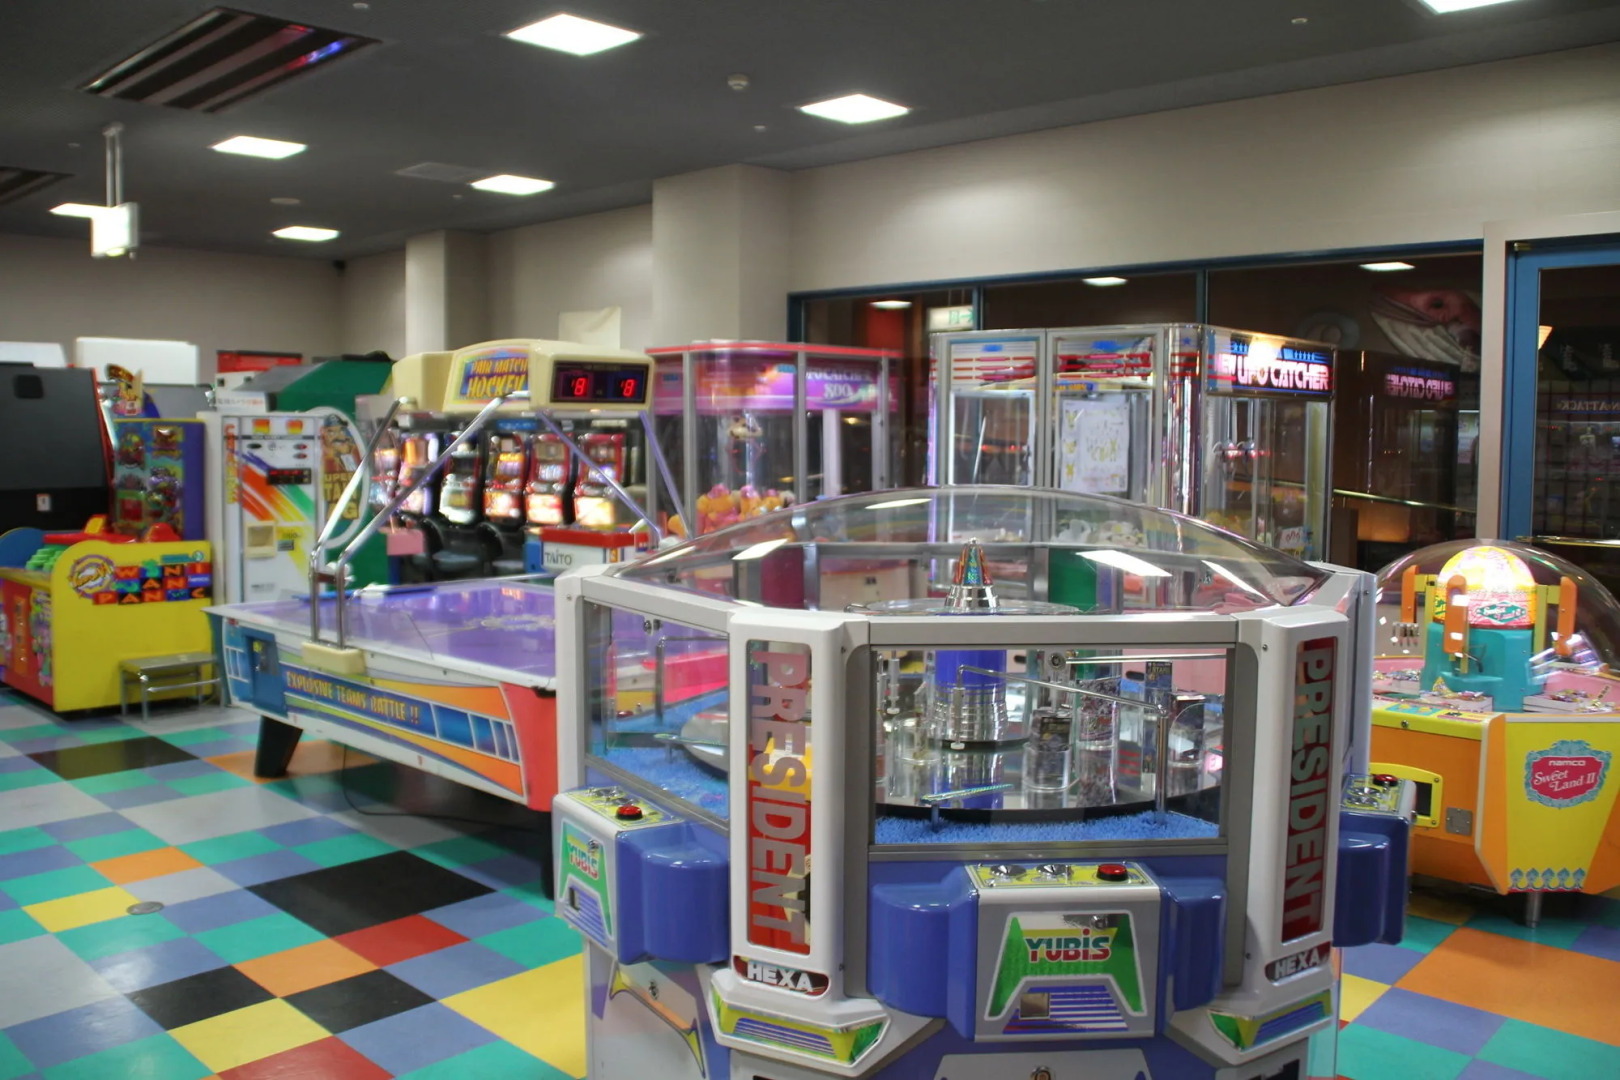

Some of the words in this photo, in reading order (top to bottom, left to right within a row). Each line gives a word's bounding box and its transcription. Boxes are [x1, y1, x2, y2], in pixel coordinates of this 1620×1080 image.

[471, 359, 493, 375] PAIR
[494, 357, 529, 374] MATCH
[1215, 353, 1237, 376] EW
[1270, 358, 1330, 391] CATCHER
[467, 374, 527, 398] HOCKEY
[545, 549, 573, 566] TAITO
[286, 670, 333, 700] EXPLOSIVE
[336, 684, 367, 709] TEAMS
[370, 695, 406, 721] BATTLE
[1283, 648, 1333, 929] PRESIDENT
[1534, 770, 1569, 785] Sweet
[1548, 775, 1585, 792] Land
[1586, 772, 1597, 784] II
[752, 651, 808, 944] PRESIDENT
[569, 846, 599, 880] YUBIS
[1024, 927, 1111, 963] YUBIS
[747, 961, 814, 992] HEXA
[1274, 947, 1321, 981] HEXA
